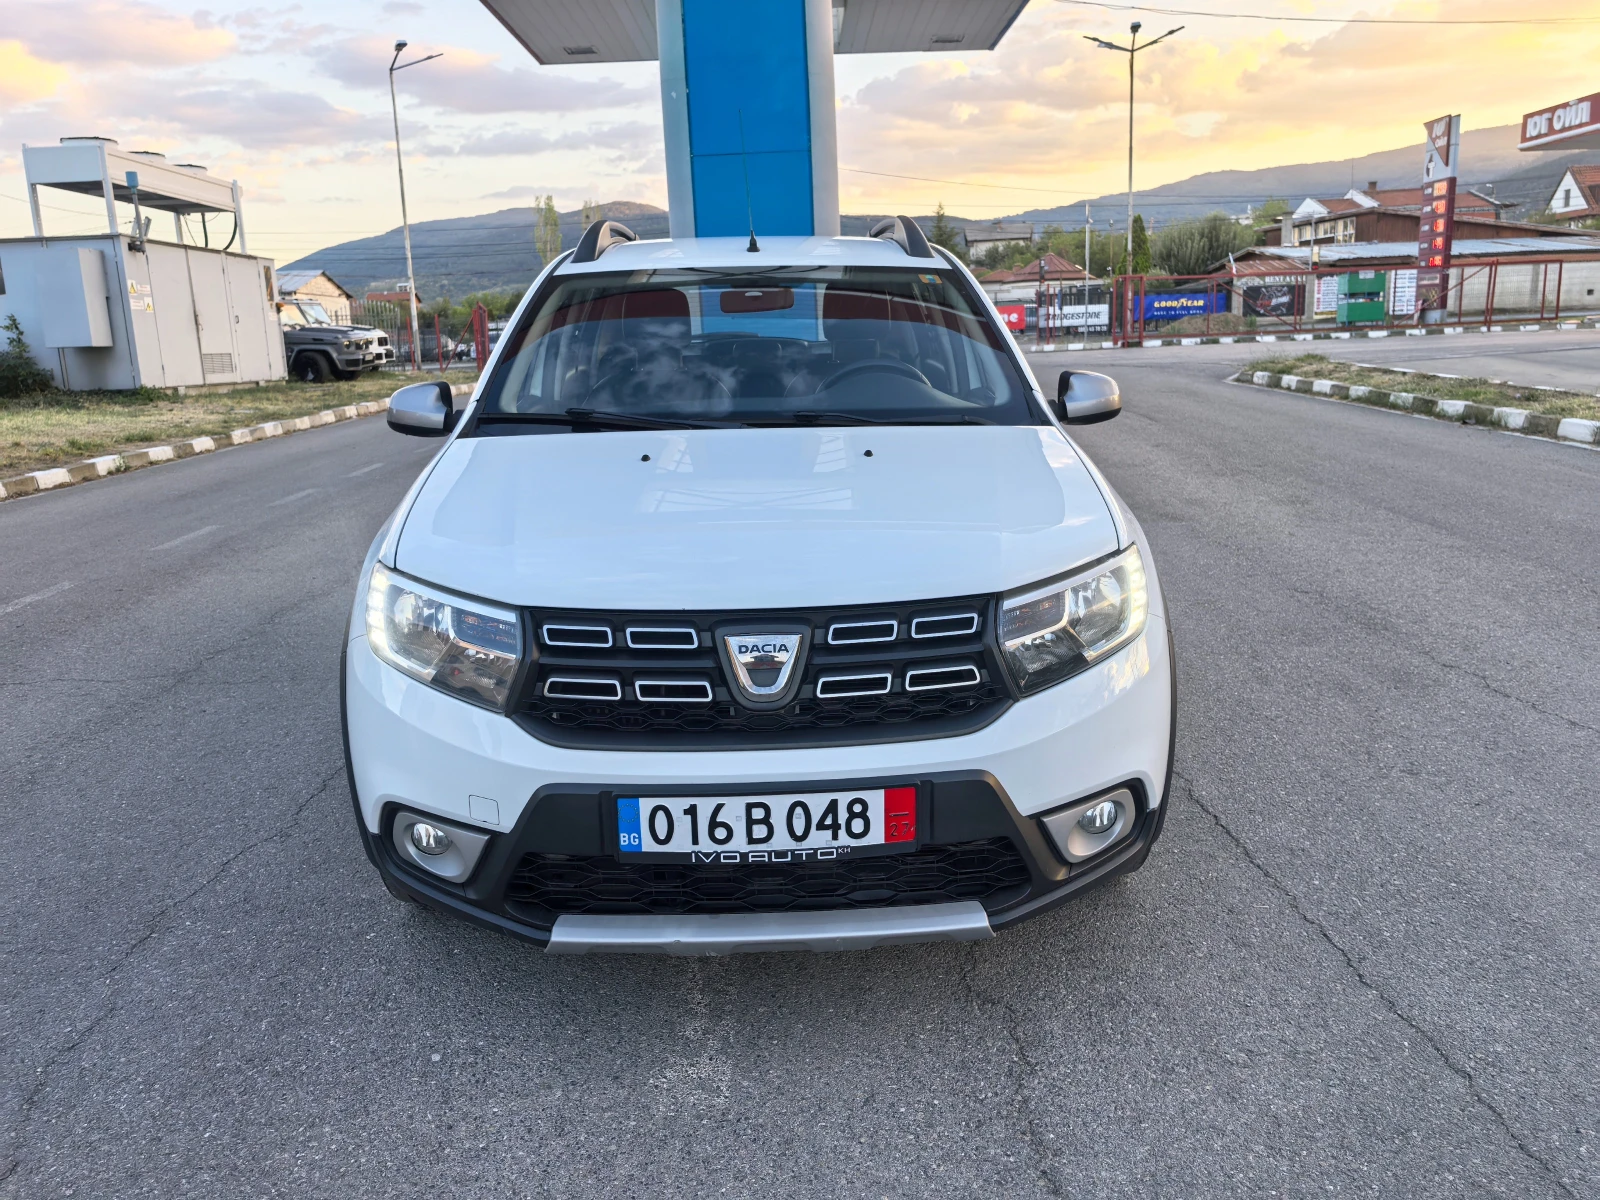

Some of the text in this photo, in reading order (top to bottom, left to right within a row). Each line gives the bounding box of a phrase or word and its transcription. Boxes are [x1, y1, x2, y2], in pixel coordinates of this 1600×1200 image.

[1526, 99, 1591, 138] ЮГ ОЙЛ
[1265, 275, 1283, 283] RENT
[1285, 275, 1291, 283] A
[1154, 298, 1204, 308] GOODYEAR
[1045, 311, 1102, 321] BRIDGESTONE
[738, 643, 789, 655] DACIA
[786, 797, 871, 843] 048
[620, 833, 640, 846] BG
[691, 852, 740, 863] IVO
[748, 848, 837, 863] AUTO
